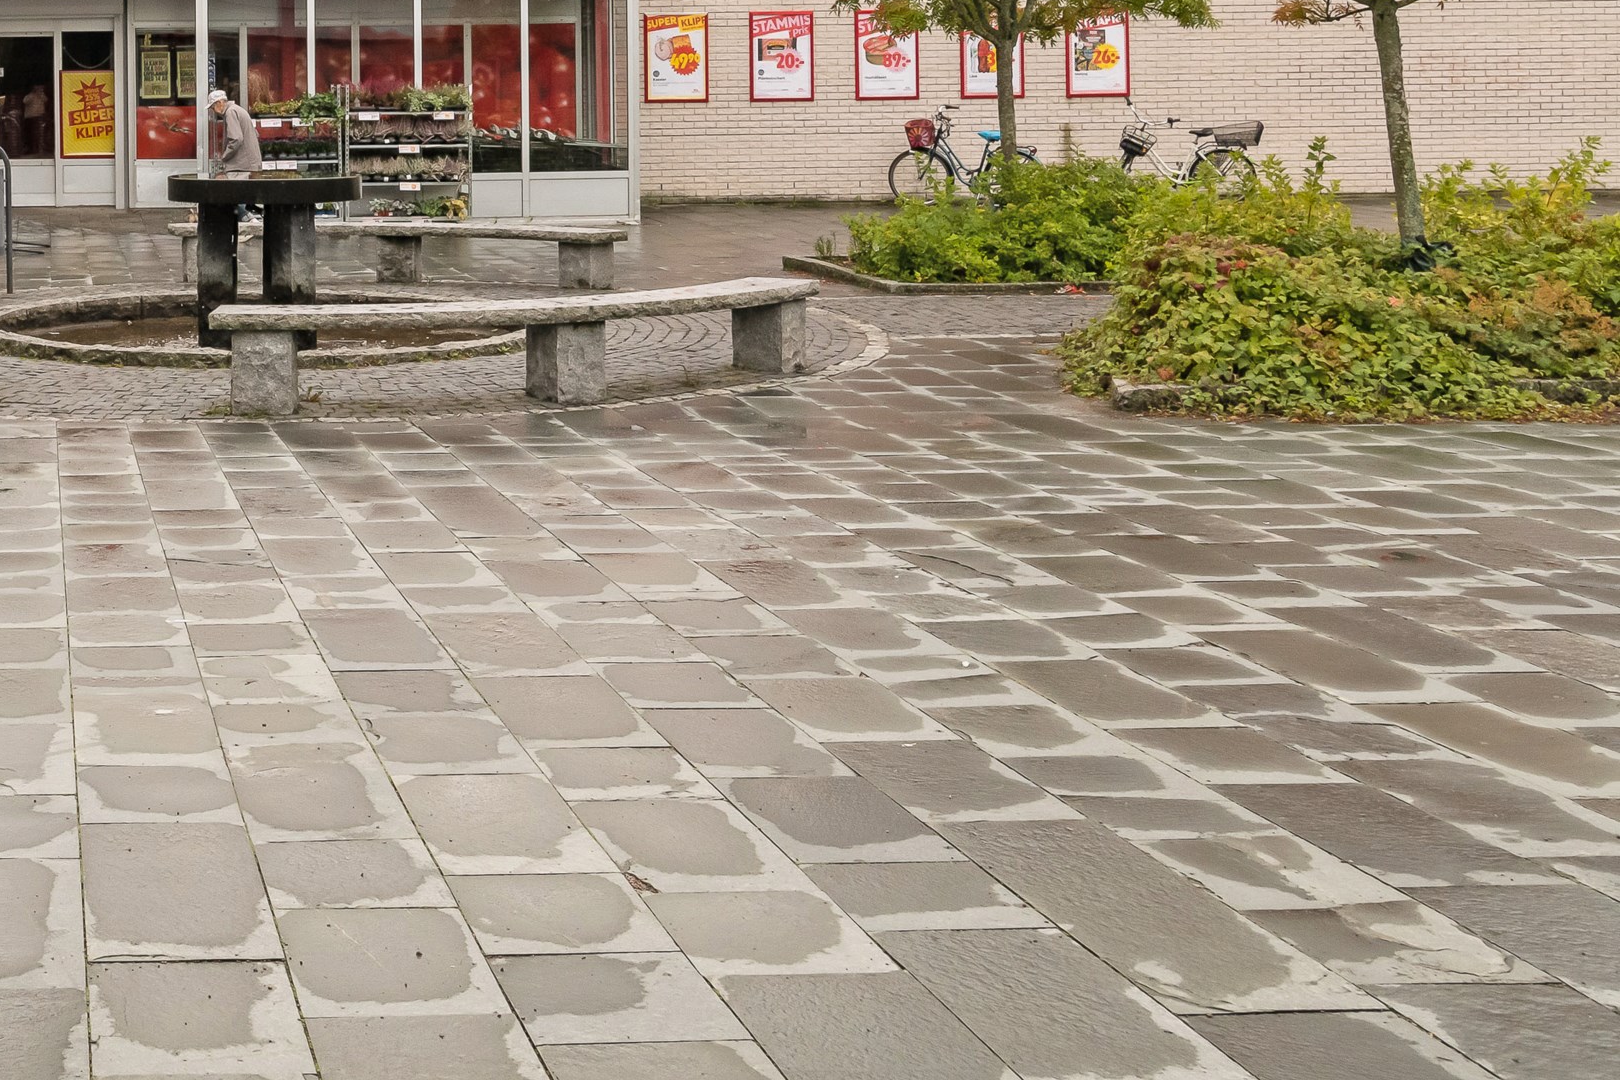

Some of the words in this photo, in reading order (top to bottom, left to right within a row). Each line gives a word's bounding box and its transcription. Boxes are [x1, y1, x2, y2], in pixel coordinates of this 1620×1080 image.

[647, 15, 678, 30] SUPER
[753, 15, 810, 34] STAMMIS
[793, 26, 809, 37] pris
[73, 107, 114, 124] SUPER
[75, 125, 113, 139] KLIPP
